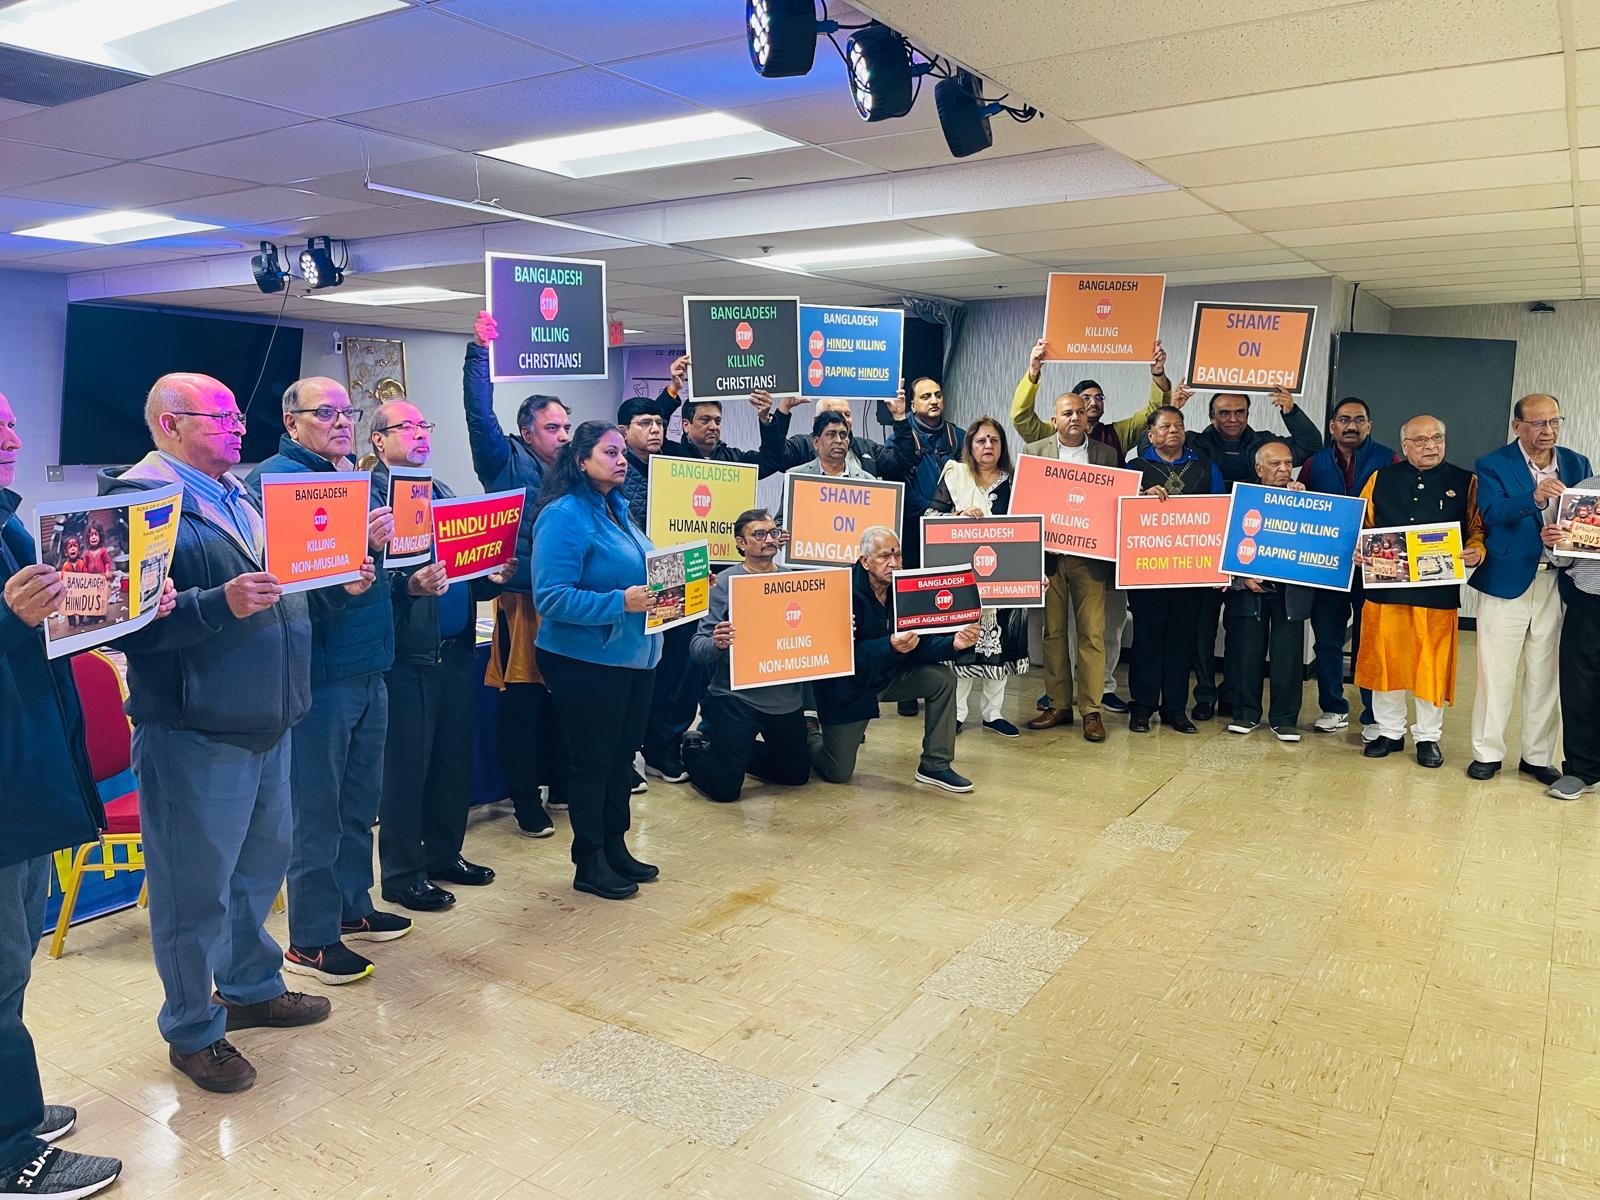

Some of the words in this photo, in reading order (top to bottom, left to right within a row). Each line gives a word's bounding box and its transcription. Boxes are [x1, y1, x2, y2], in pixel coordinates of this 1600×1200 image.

[515, 266, 583, 286] BANGLADESH
[1078, 280, 1139, 291] BANGLADESH
[541, 298, 557, 310] STOP
[1096, 305, 1112, 314] STOP
[711, 306, 777, 320] BANGLADESH
[823, 313, 879, 326] BANGLADESH
[1226, 313, 1281, 331] SHAME
[531, 327, 569, 342] KILLING
[736, 331, 753, 341] STOP
[1085, 326, 1119, 337] KILLING
[809, 338, 824, 350] STOP
[826, 338, 854, 351] HINDU
[855, 339, 886, 351] KILLING
[1066, 344, 1133, 354] NON-MUSLIMA
[1238, 341, 1262, 357] ON
[519, 353, 582, 368] CHRISTIANS!
[727, 354, 765, 368] KILLING
[809, 367, 823, 379] STOP
[824, 366, 856, 378] RAPING
[857, 367, 890, 379] HINDUS
[1196, 366, 1295, 386] BANGLADESH
[716, 374, 777, 390] CHRISTIANS!
[671, 463, 740, 483] BANGLADESH
[1045, 466, 1115, 486] BANGLADESH
[295, 487, 348, 501] BANGLADESH
[693, 495, 710, 507] STOP
[820, 486, 871, 506] SHAME
[1068, 493, 1085, 504] STOP
[1264, 493, 1333, 512] BANGLADESH
[314, 515, 328, 525] STOP
[415, 510, 424, 524] ON
[438, 514, 487, 538] HINDU
[490, 507, 520, 529] LIVES
[833, 515, 855, 532] ON
[1050, 513, 1090, 529] KILLING
[1140, 513, 1158, 526] WE
[1161, 512, 1211, 526] DEMAND
[669, 518, 708, 533] HUMAN
[1244, 517, 1261, 528] STOP
[1263, 518, 1298, 533] HINDU
[1300, 523, 1339, 538] KILLING
[951, 528, 1014, 539] BANGLADESH
[307, 538, 336, 552] KILLING
[1127, 535, 1172, 549] STRONG
[1175, 534, 1222, 547] ACTIONS
[454, 540, 503, 568] MATTER
[975, 555, 995, 566] STOP
[1239, 545, 1256, 556] STOP
[1257, 545, 1297, 560] RAPING
[1298, 551, 1340, 568] HINDUS
[291, 554, 350, 574] NON-MUSLIMA
[1136, 557, 1169, 570] FROM
[1171, 556, 1193, 569] THE
[1196, 556, 1212, 568] UN
[764, 578, 826, 595] BANGLADESH
[917, 577, 965, 588] BANGLADESH
[993, 585, 1039, 594] HUMANITY!
[936, 595, 952, 604] STOP
[786, 610, 801, 621] STOP
[899, 617, 920, 626] CRIMES
[921, 615, 948, 624] AGAINST
[949, 611, 980, 621] HUMANITY!
[776, 635, 812, 651] KILLING
[759, 654, 830, 673] NON-MUSLIMA
